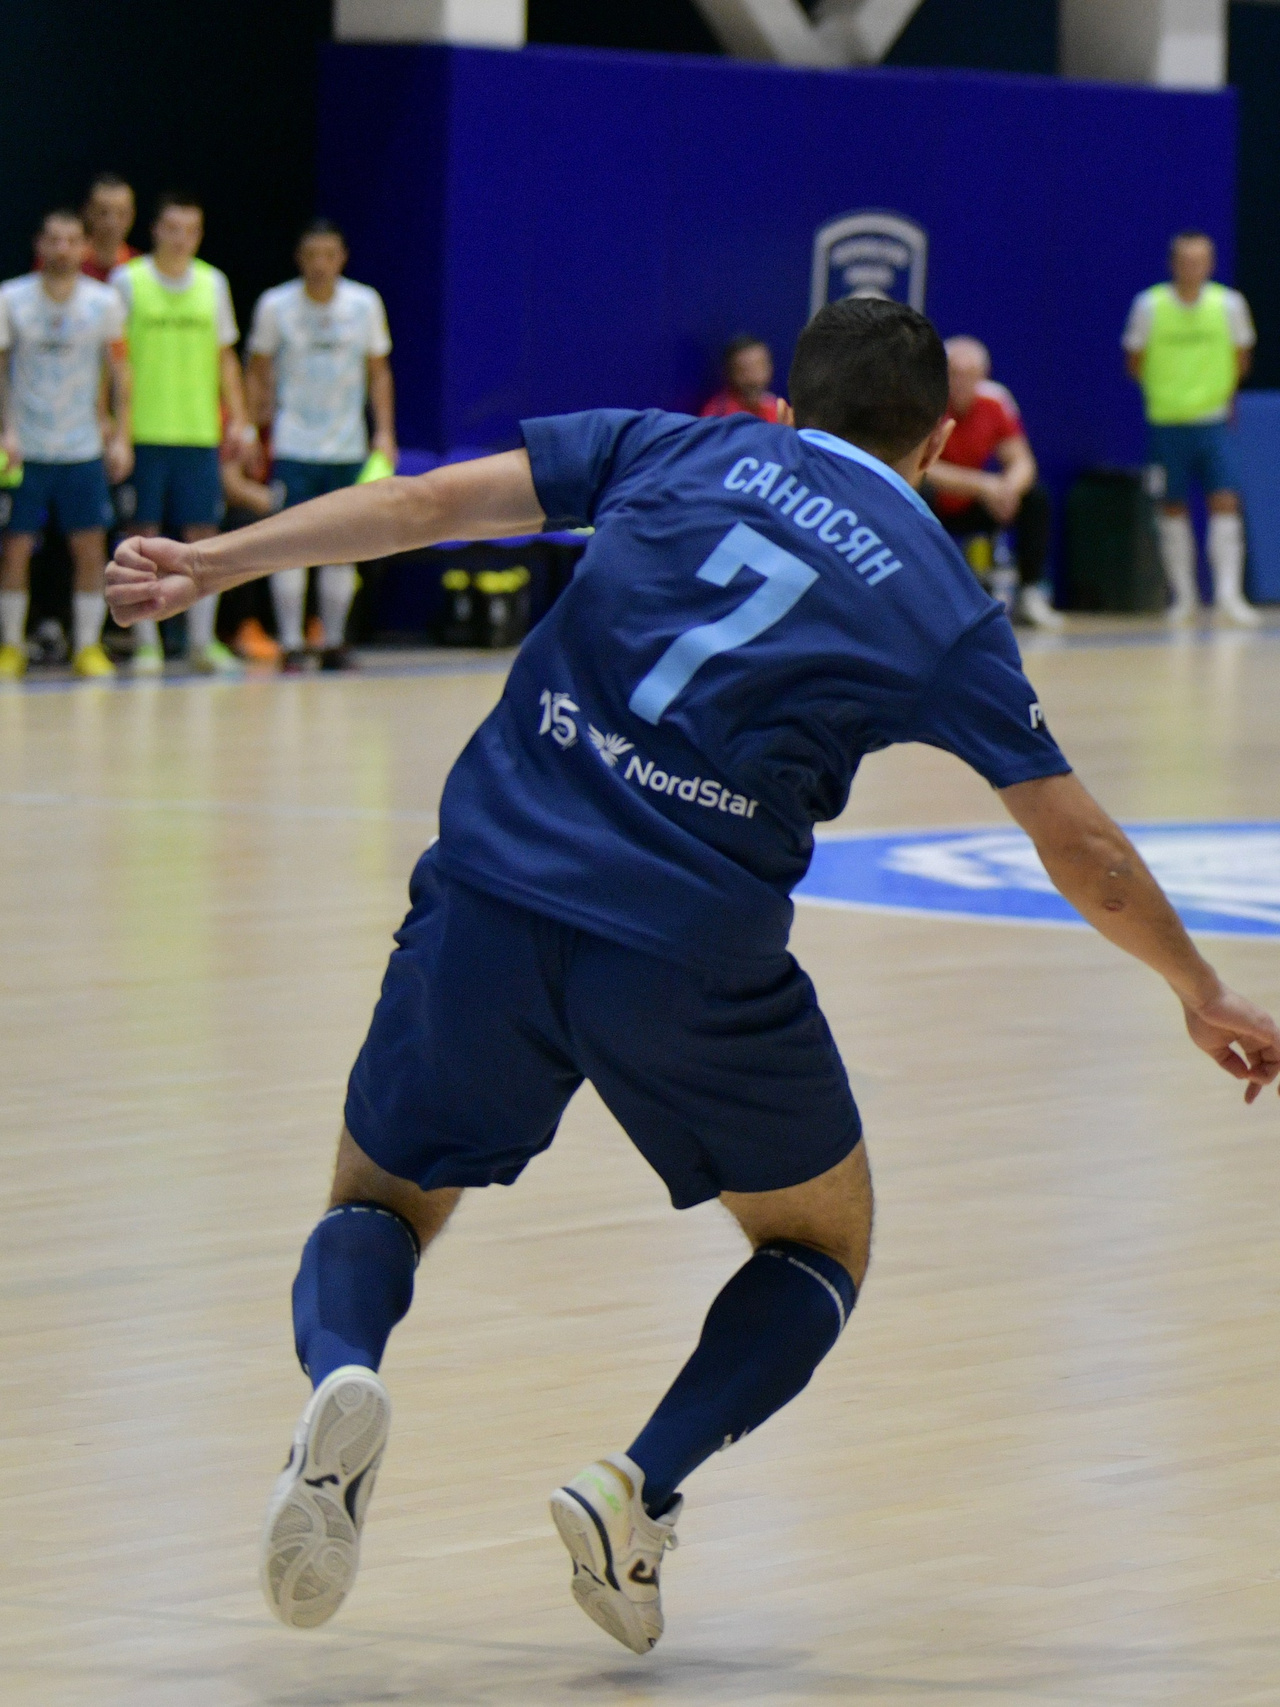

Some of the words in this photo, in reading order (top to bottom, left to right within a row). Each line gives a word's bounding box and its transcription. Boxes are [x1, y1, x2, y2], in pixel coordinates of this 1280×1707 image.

[724, 457, 903, 587] САНОСЯН
[629, 522, 820, 726] 7
[539, 688, 580, 750] 15
[623, 755, 759, 819] NordStar
